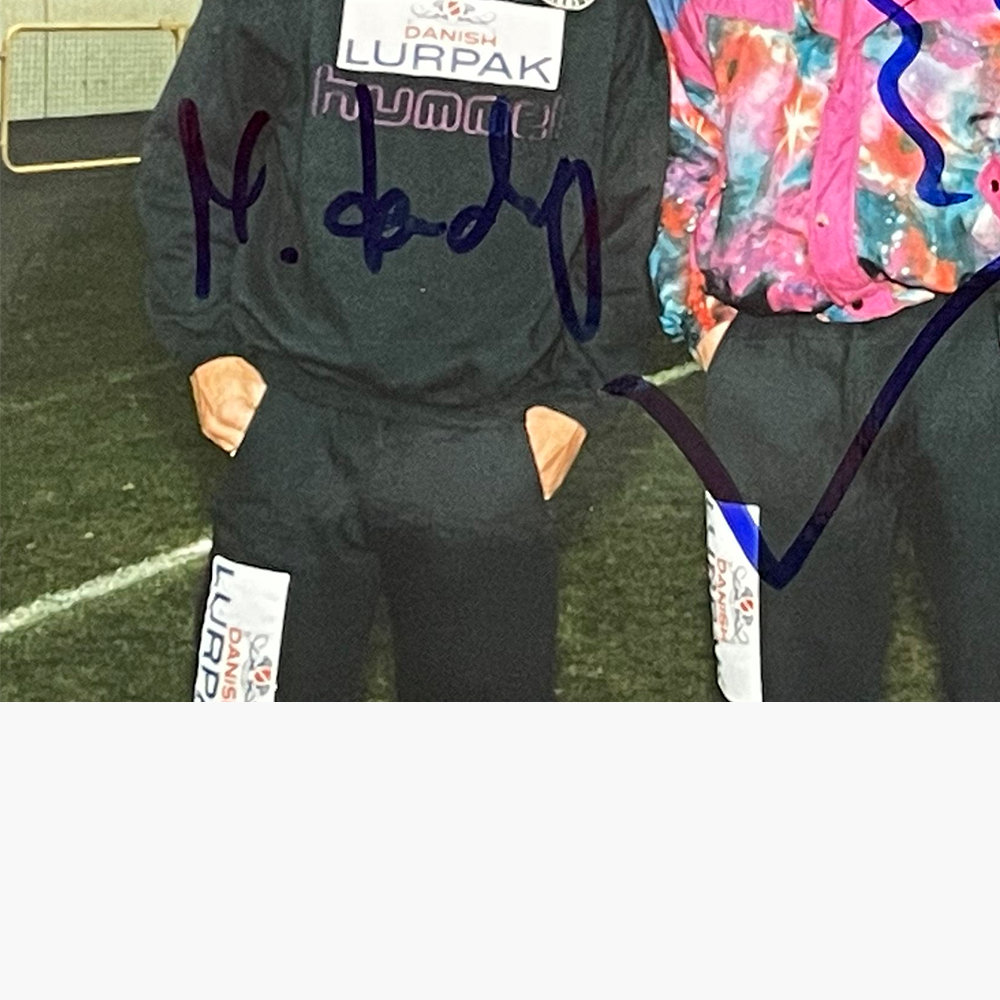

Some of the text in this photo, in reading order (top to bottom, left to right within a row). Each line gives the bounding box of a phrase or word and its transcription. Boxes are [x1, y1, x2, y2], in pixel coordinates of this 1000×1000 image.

[403, 24, 498, 48] DANISH
[345, 38, 553, 84] LURPAK
[220, 626, 243, 702] DANIS
